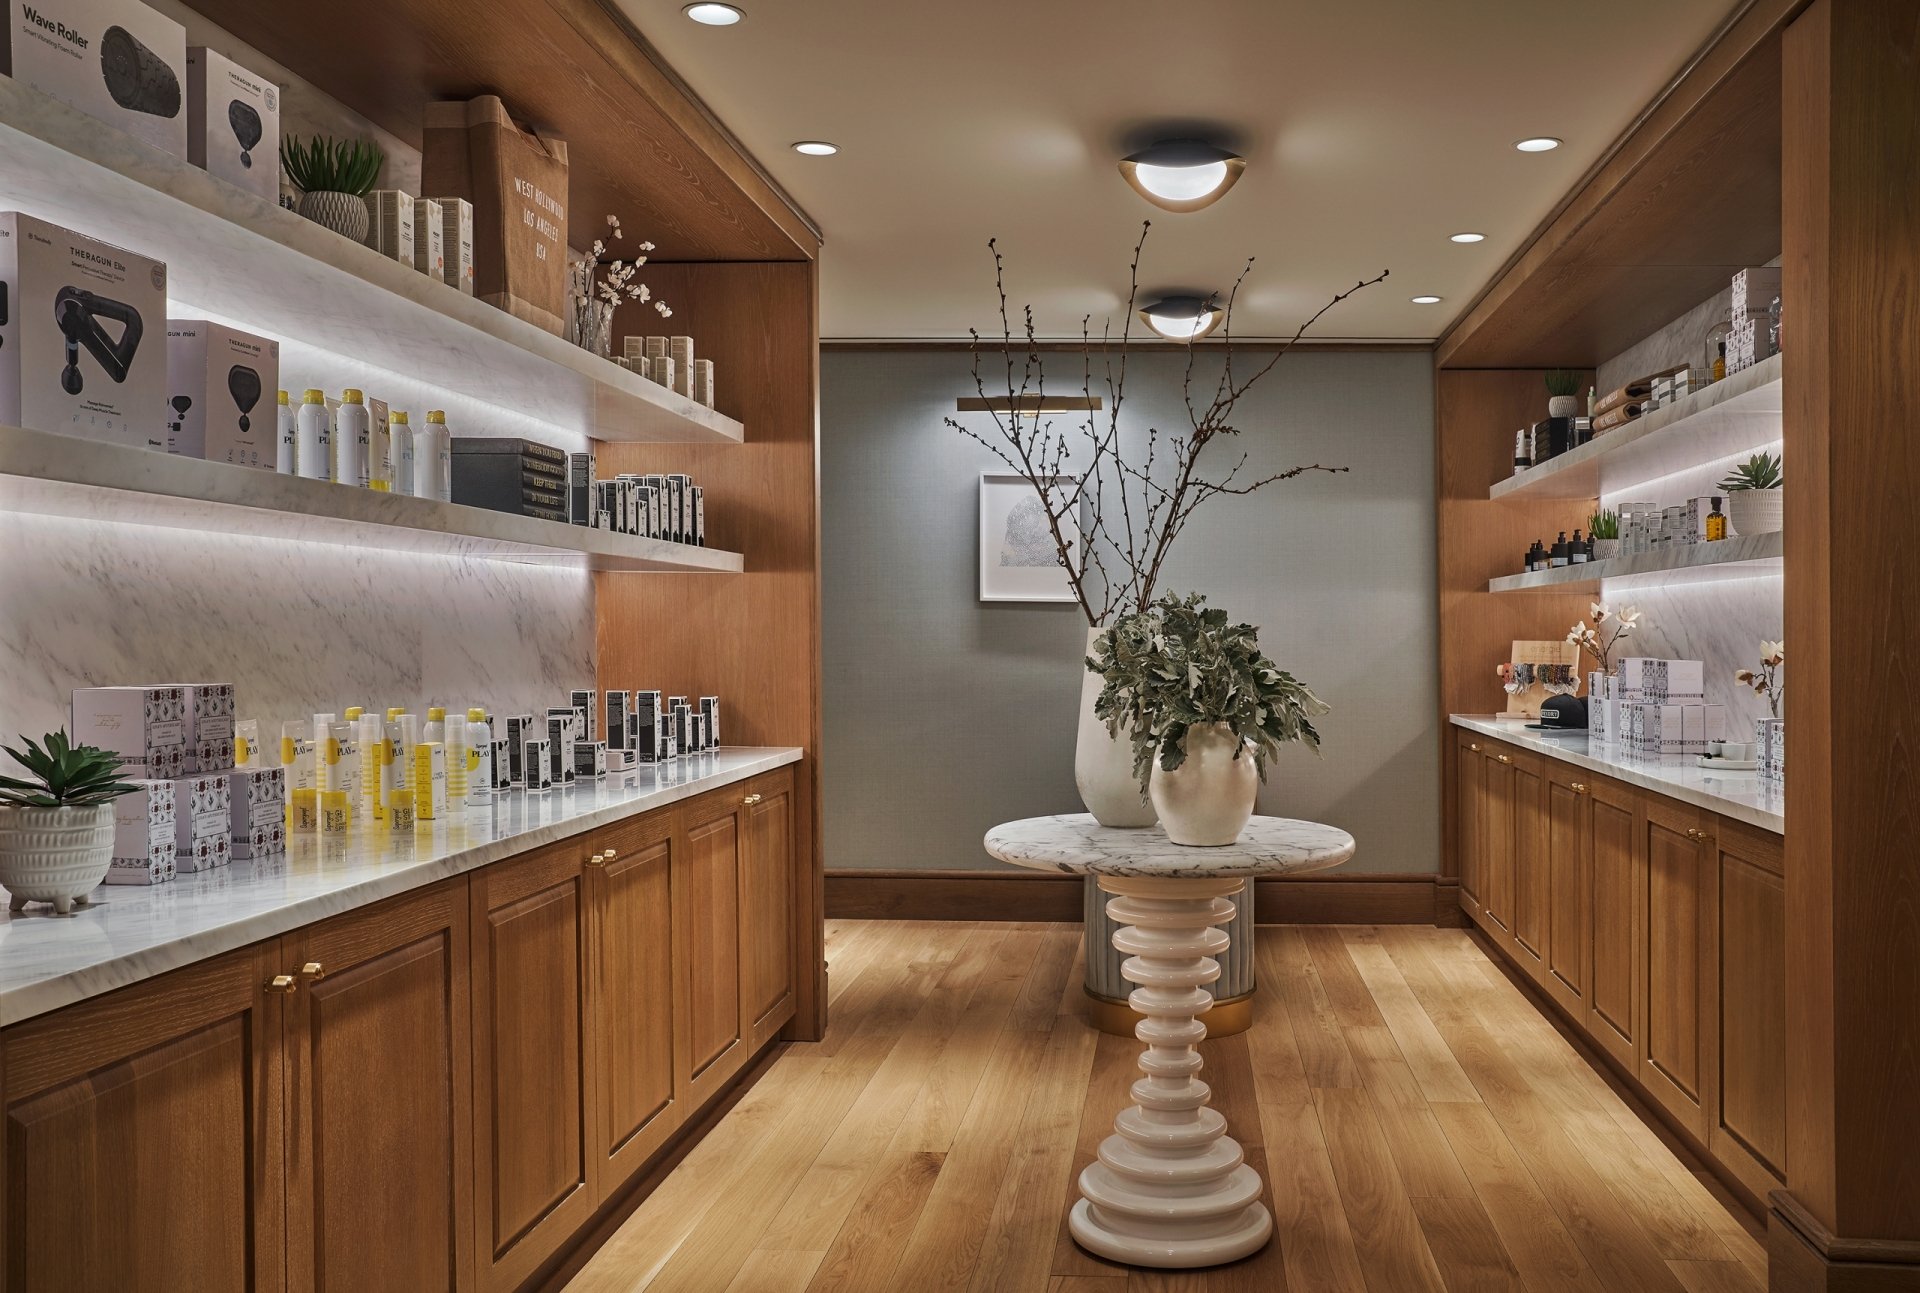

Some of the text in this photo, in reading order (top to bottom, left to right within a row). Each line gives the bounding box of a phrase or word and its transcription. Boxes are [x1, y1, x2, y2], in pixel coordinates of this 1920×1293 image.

[22, 3, 89, 49] Wave Roller
[514, 176, 564, 221] WEST HOLLYWOOD
[523, 207, 559, 242] LOS ANGELES
[69, 246, 126, 272] THERAGUN Elite
[536, 242, 546, 261] USA
[245, 745, 258, 756] PLAY
[293, 746, 306, 756] PLAY
[337, 746, 352, 757] PLAY
[391, 747, 404, 758] PLAY
[471, 750, 491, 758] PLAY
